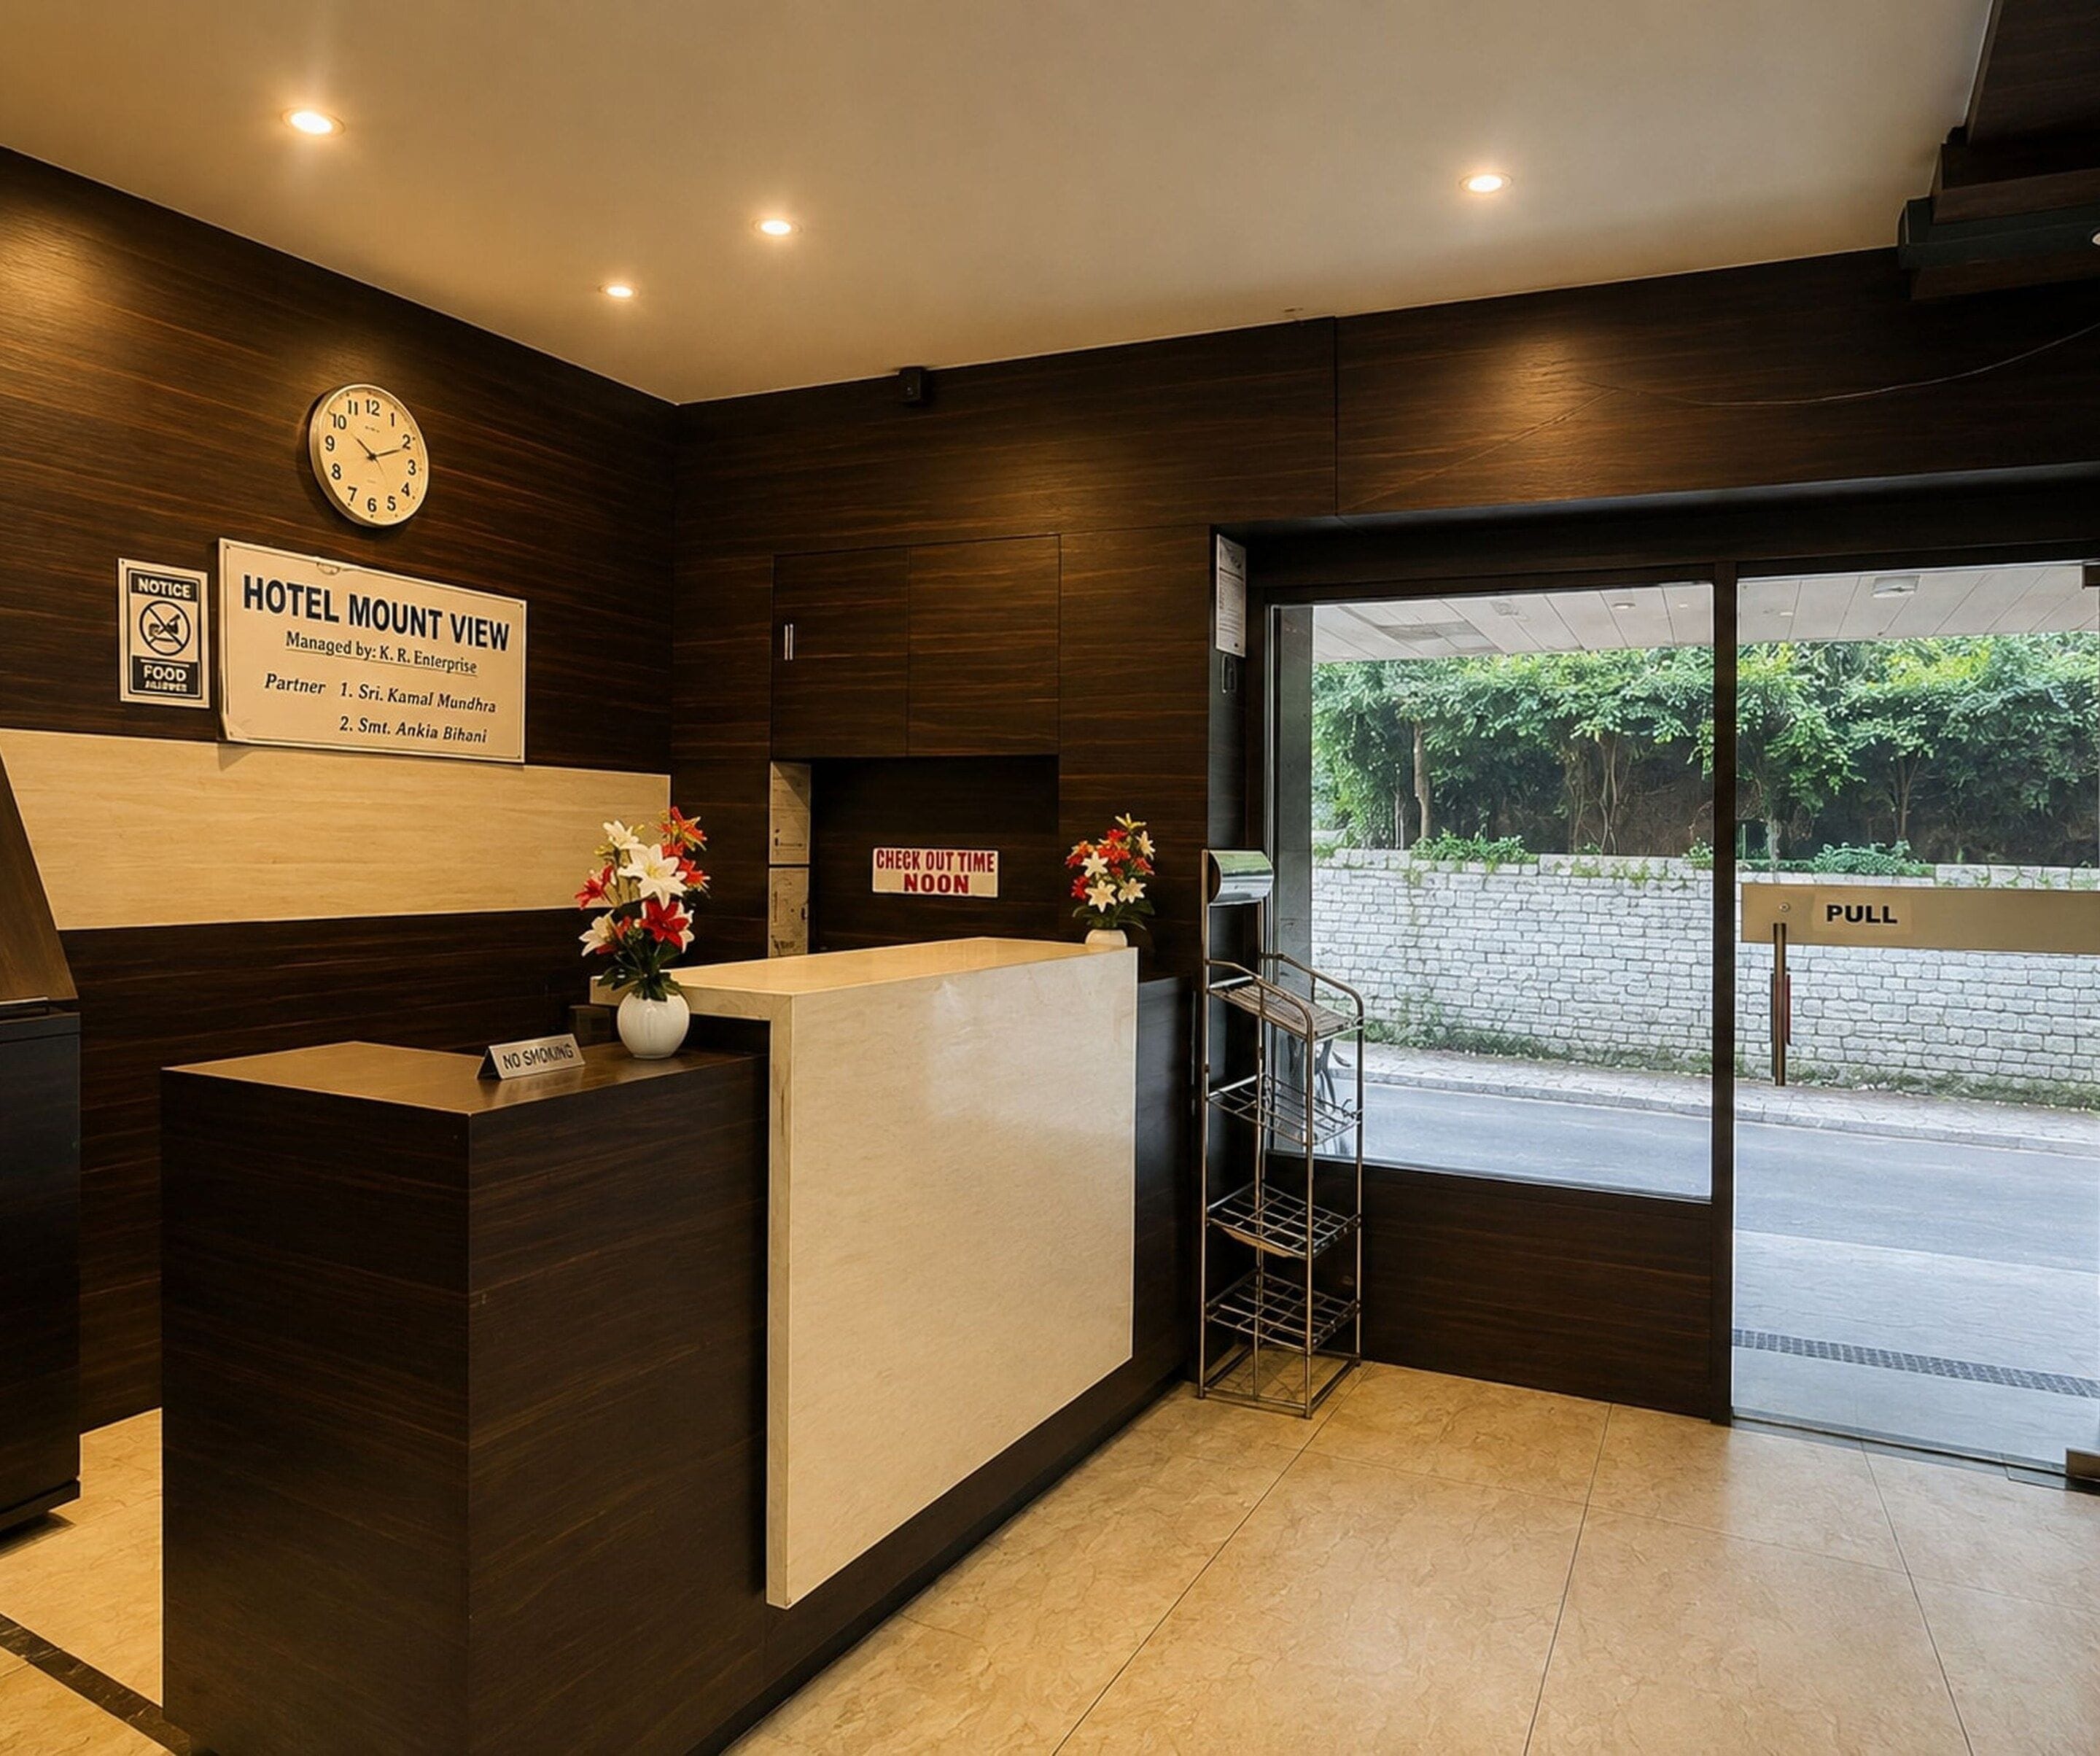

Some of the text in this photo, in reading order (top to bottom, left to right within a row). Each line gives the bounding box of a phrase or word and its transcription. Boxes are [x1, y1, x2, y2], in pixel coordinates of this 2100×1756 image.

[347, 400, 358, 415] 11
[365, 400, 380, 416] 12
[332, 413, 346, 430] 10
[390, 412, 394, 427] 1
[325, 435, 335, 451] 9
[402, 434, 411, 450] 2
[332, 463, 341, 480] 8
[408, 459, 416, 475] 3
[348, 486, 357, 502] 7
[401, 482, 410, 497] 4
[367, 497, 377, 512] 6
[386, 496, 396, 510] 5
[138, 578, 191, 598] NOTICE
[244, 575, 509, 651] HOTEL MOUNT VIEW
[286, 631, 477, 673] Managed by: K. R. Enterprise
[144, 664, 187, 681] FOOD
[265, 672, 496, 713] Partner 1. Sri. Kamal Mundhra
[340, 715, 487, 743] 2. Smt. Ankia Bihani
[876, 850, 995, 873] CHECK OUT TIME
[903, 873, 969, 894] NOON
[1827, 905, 1898, 924] PULL
[502, 1052, 521, 1069] NO
